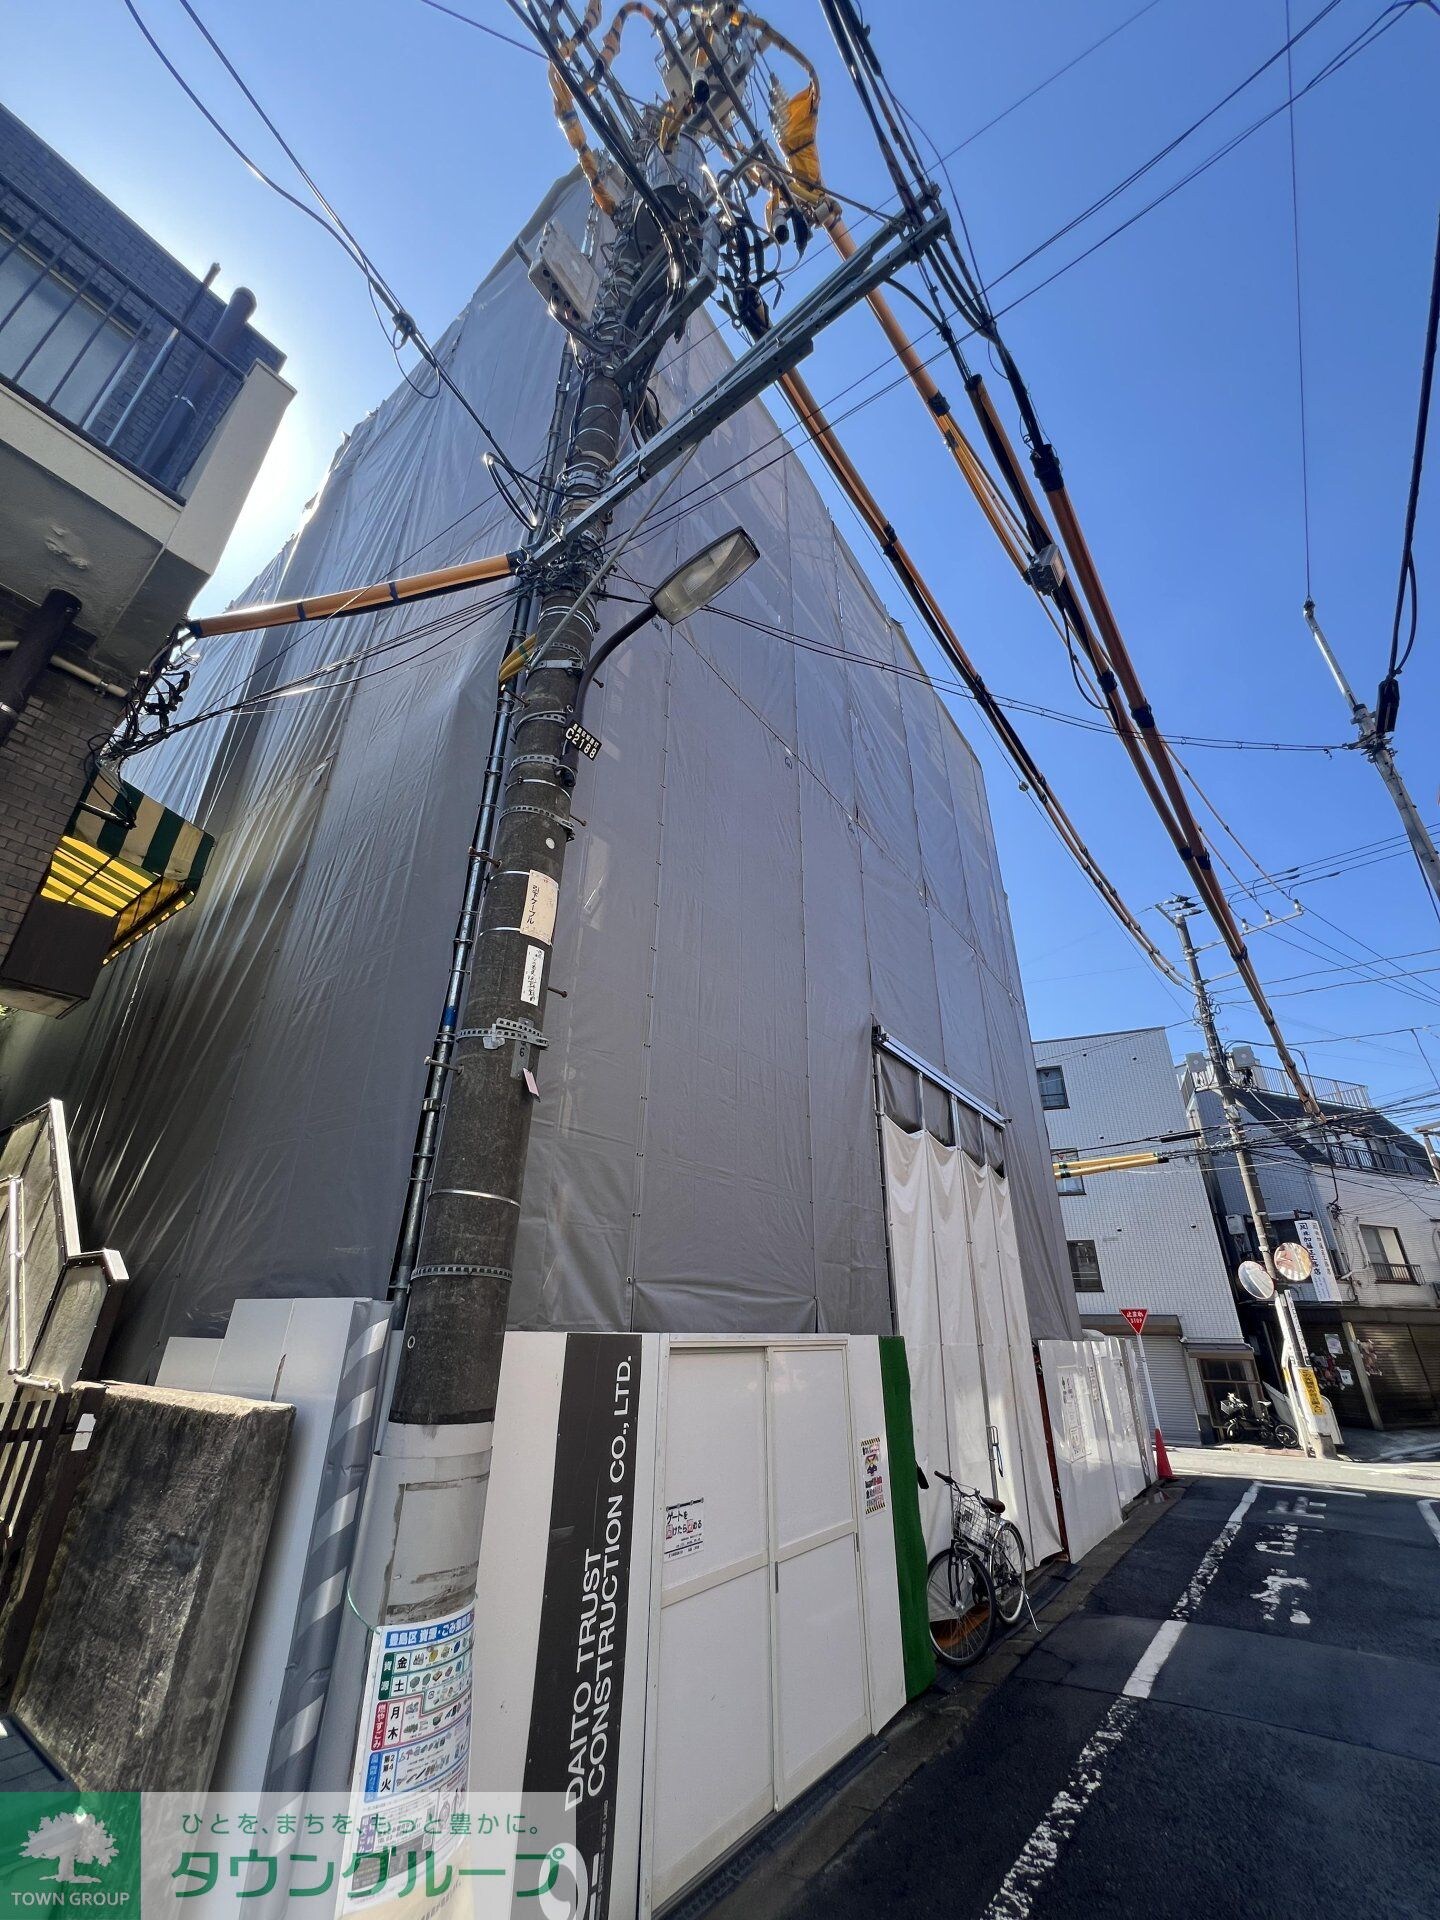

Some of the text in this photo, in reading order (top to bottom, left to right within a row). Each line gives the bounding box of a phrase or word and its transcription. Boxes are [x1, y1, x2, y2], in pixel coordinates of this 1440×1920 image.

[566, 727, 597, 758] C2188
[1126, 1310, 1144, 1318] 止まれ
[667, 1510, 688, 1525] ゲートを
[587, 1355, 632, 1798] CONSTRUCTION CO., LTD.
[397, 1656, 407, 1669] 金
[393, 1680, 404, 1692] 土
[564, 1549, 602, 1811] DAITO TRUST
[391, 1706, 400, 1720] 月
[388, 1727, 398, 1740] 木
[381, 1778, 391, 1793] 火
